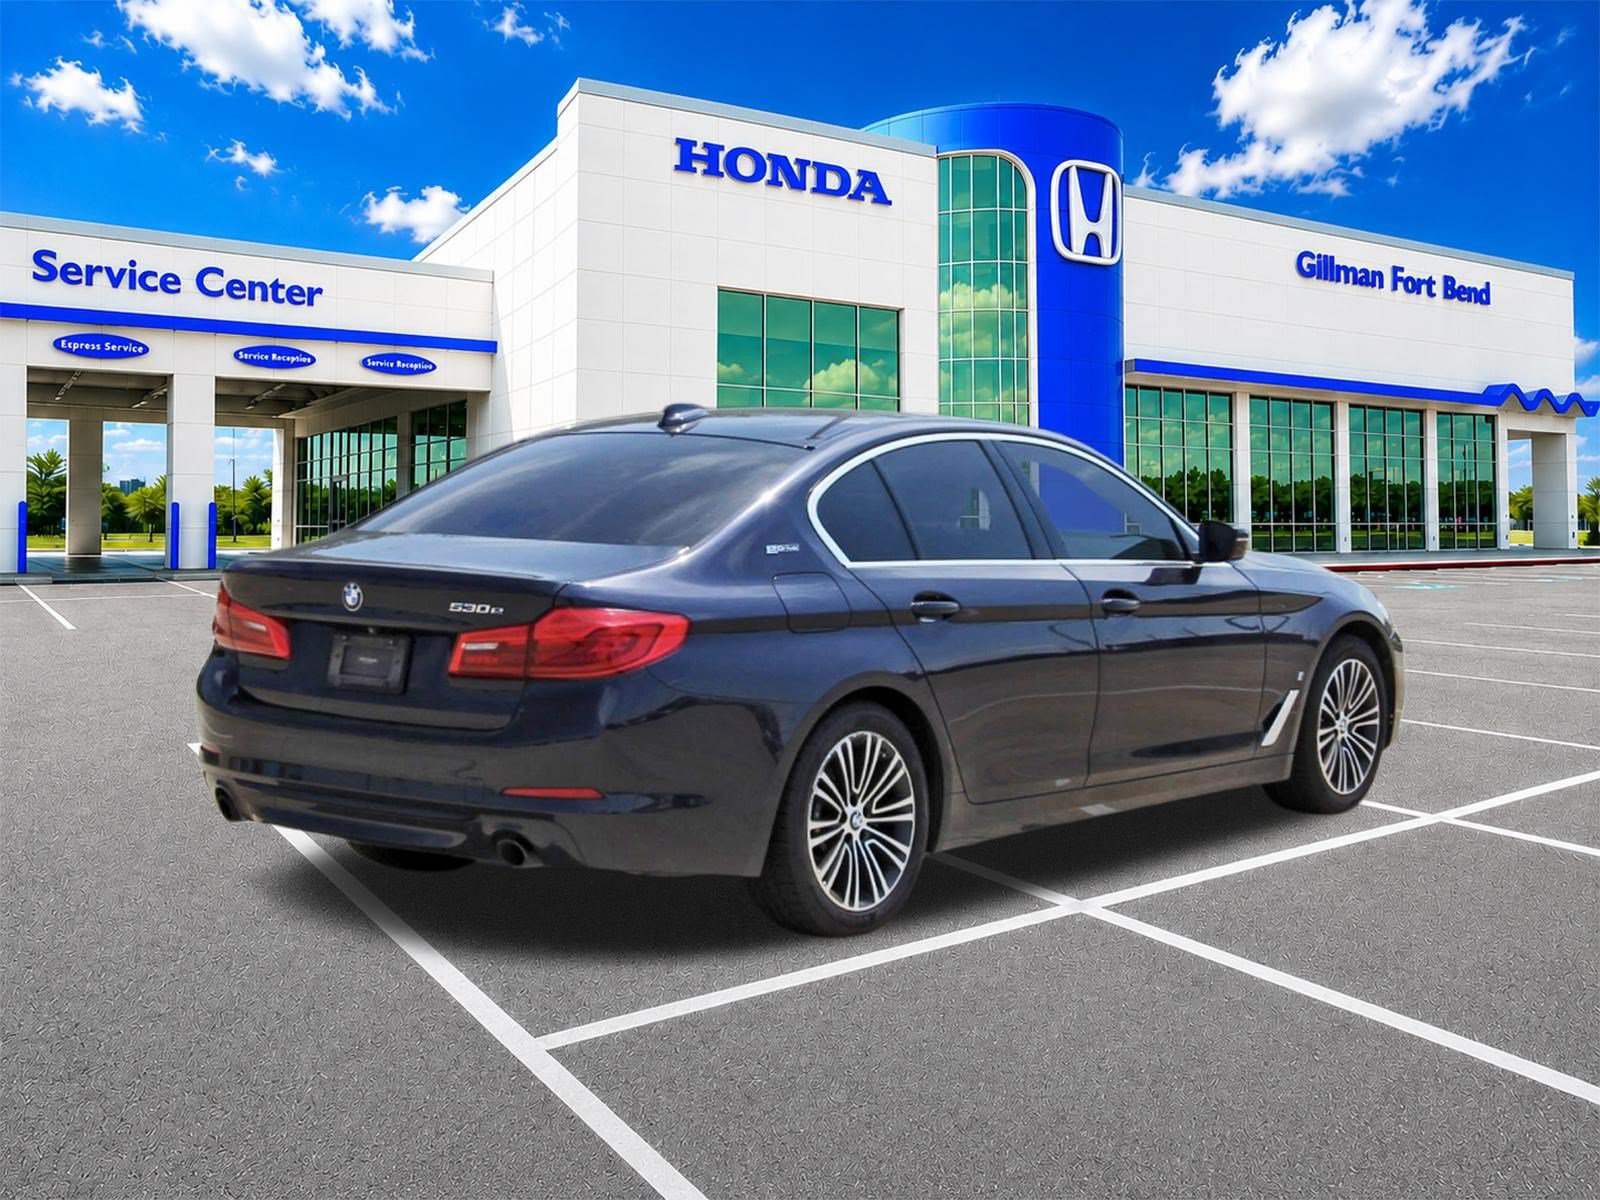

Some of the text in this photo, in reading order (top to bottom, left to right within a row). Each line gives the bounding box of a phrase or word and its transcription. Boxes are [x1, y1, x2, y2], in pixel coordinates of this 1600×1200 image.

[673, 137, 892, 206] HONDA
[32, 249, 323, 307] Service Center
[1296, 250, 1491, 305] Gillman Fort Bend
[104, 342, 144, 354] Service
[238, 351, 269, 361] Service
[367, 358, 394, 368] Service
[448, 602, 504, 616] 530e
